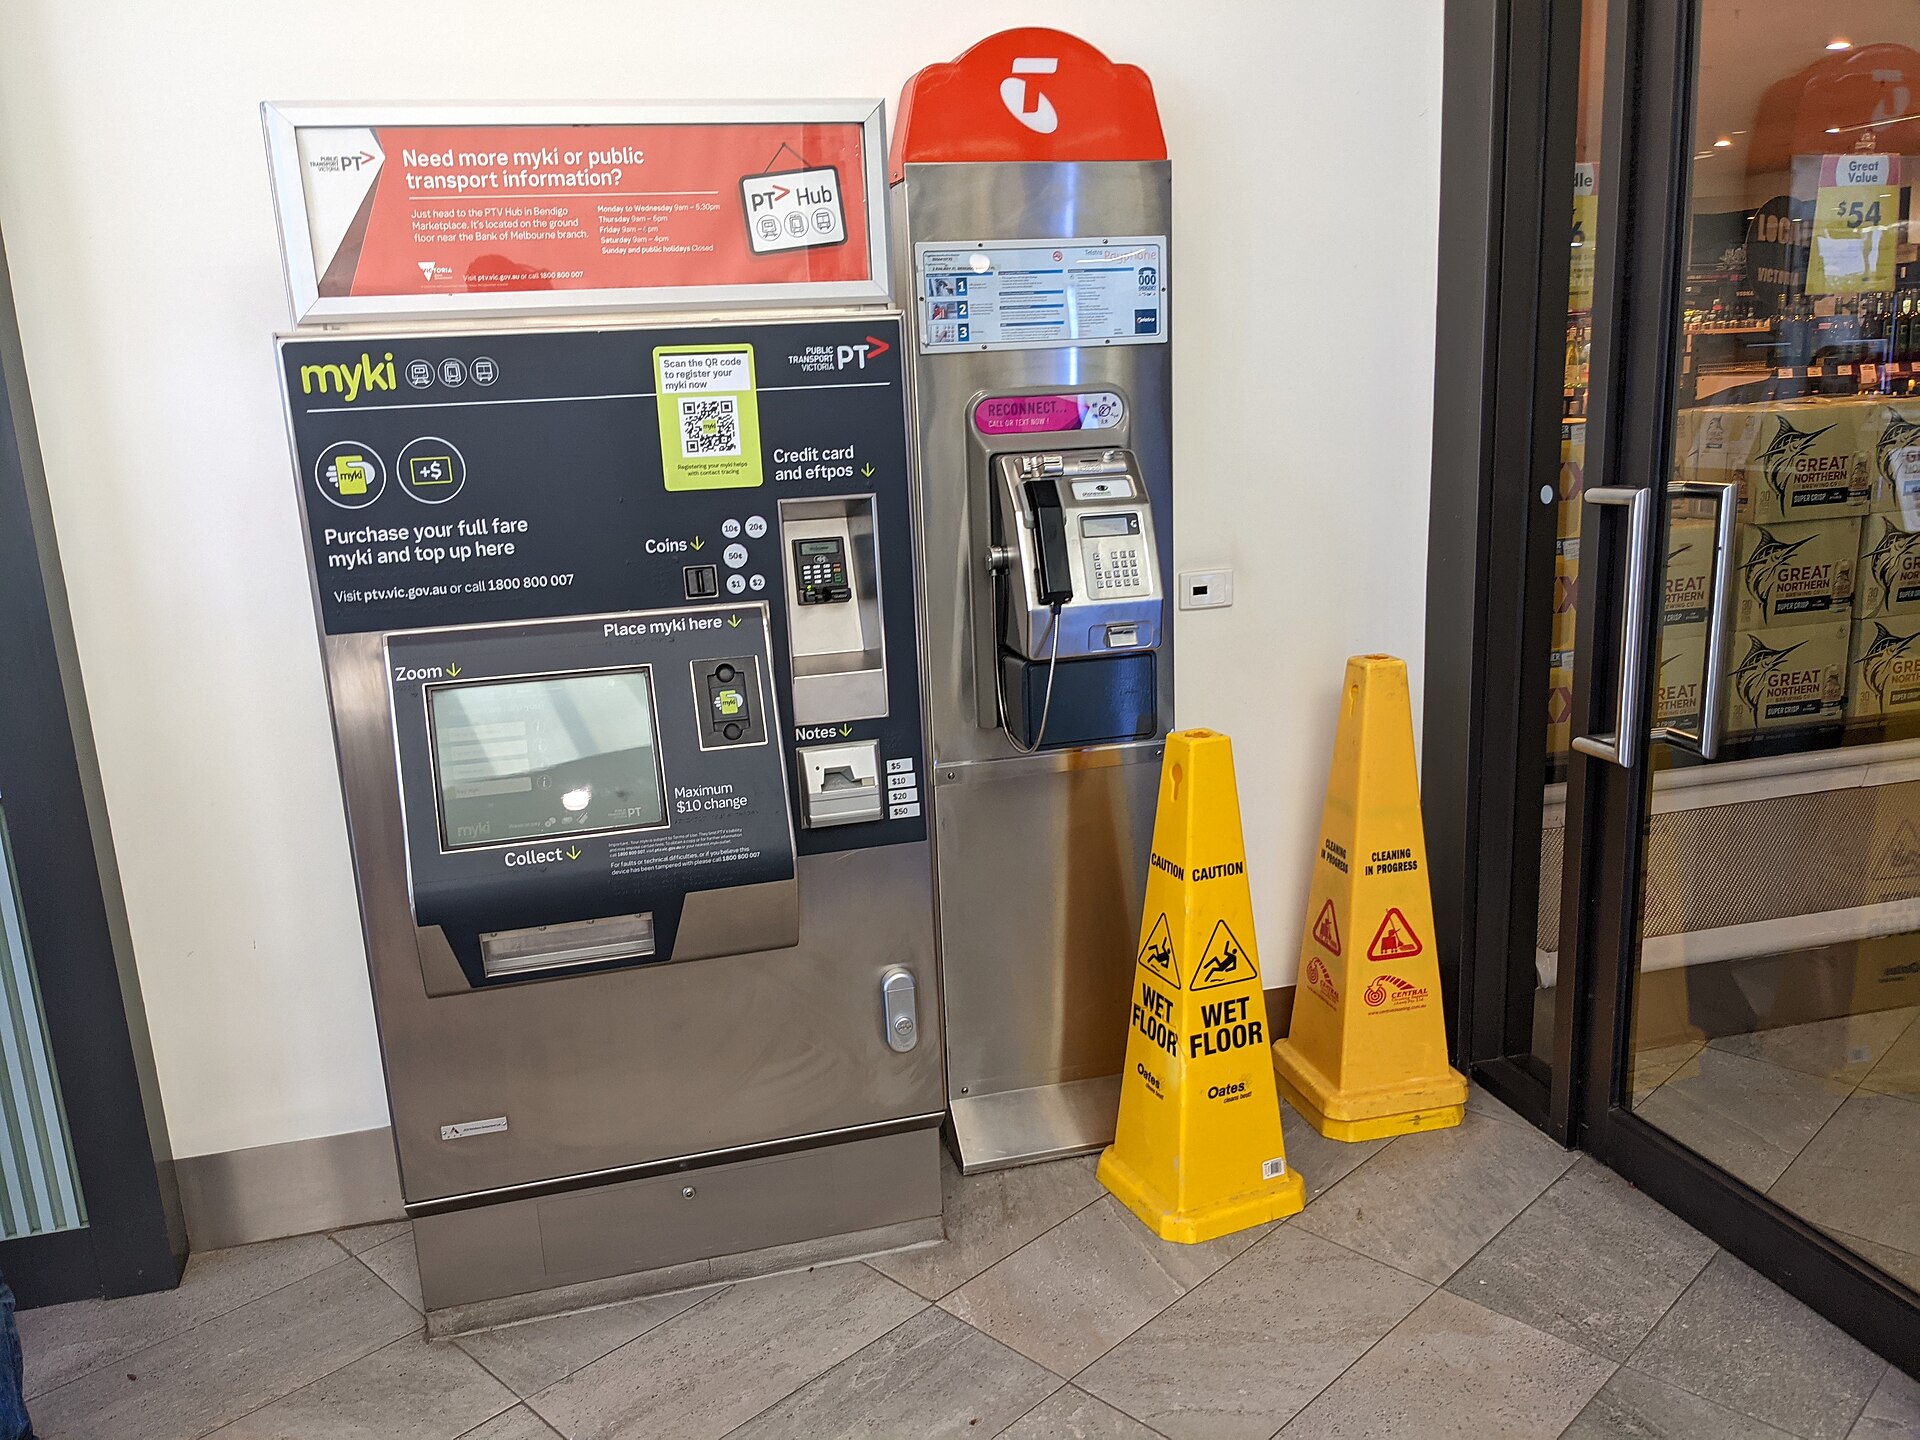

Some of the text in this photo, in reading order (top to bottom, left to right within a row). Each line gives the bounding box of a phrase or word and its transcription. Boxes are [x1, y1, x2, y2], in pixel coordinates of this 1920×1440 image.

[402, 147, 645, 170] Need more myki or public
[1848, 161, 1879, 171] Great
[405, 168, 623, 192] transport information?
[1848, 172, 1878, 183] Value
[796, 185, 832, 206] Hub
[411, 206, 569, 219] Just head to the PTV Hub in Bendigo
[597, 205, 624, 214] Monday
[634, 204, 673, 213] Wednesday
[1837, 200, 1882, 229] $54
[412, 218, 579, 232] Marketplace. It's located on the ground
[599, 215, 630, 224] Thursday
[414, 229, 589, 243] floor near the Bank of Melbourne branch.
[600, 236, 632, 244] Saturday
[601, 244, 714, 255] Sunday and public holidays Closed
[957, 280, 966, 292] 1
[1138, 274, 1157, 285] 000
[958, 303, 968, 316] 2
[959, 326, 968, 338] 3
[805, 346, 834, 355] PUBLIC
[663, 357, 741, 368] Scan the QR code
[788, 354, 834, 364] TRANSPORT
[664, 369, 732, 380] to register your
[801, 363, 835, 372] VICTORIA
[300, 352, 398, 402] myki
[665, 380, 707, 391] myki now
[773, 445, 855, 463] Credit card
[1795, 455, 1849, 472] GREAT
[340, 470, 363, 482] myki
[775, 464, 853, 482] and eftpos
[1793, 470, 1848, 484] NORTHERN
[1801, 481, 1829, 489] BREWING
[1793, 494, 1810, 503] SUPER
[1810, 492, 1827, 502] CRISP
[325, 517, 529, 546] Purchase your full fare
[645, 538, 688, 554] Coins
[328, 540, 515, 570] myki and top up here
[1777, 564, 1832, 582] GREAT
[333, 573, 575, 604] Visit ptv.vic.gov.au or call 1800 800 007
[731, 580, 741, 588] $1
[752, 578, 763, 586] $2
[1664, 576, 1706, 592] REAT
[1776, 579, 1830, 593] NORTHERN
[1776, 603, 1793, 612] SUPER
[1793, 600, 1809, 610] CRISP
[603, 616, 723, 638] Place myki here
[394, 664, 443, 682] Zoom
[1892, 659, 1920, 674] GRE
[1768, 669, 1821, 687] GREAT
[1657, 684, 1697, 700] REAT
[1766, 684, 1820, 698] NORTHERN
[722, 698, 736, 708] myki
[1767, 707, 1784, 716] SUPER
[1784, 705, 1800, 714] CRISP
[795, 726, 837, 742] Notes
[891, 762, 902, 770] $5
[892, 777, 906, 785] $10
[674, 783, 733, 799] Maximum
[892, 792, 908, 801] $20
[677, 794, 748, 814] $10 change
[893, 807, 909, 816] $50
[457, 820, 491, 839] myki
[1325, 838, 1347, 860] CLEANING
[1371, 848, 1411, 862] CLEANING
[505, 849, 564, 867] Collect
[611, 851, 761, 876] device has been tampered with please call 1800 800 007
[1321, 848, 1348, 874] IN PROGRESS
[1151, 852, 1185, 881] CAUTION
[1192, 861, 1244, 882] CAUTION
[1365, 860, 1418, 876] IN PROGRESS
[1391, 987, 1429, 999] CENTRAL
[1142, 982, 1174, 1024] WET
[1201, 996, 1250, 1029] WET
[1132, 1002, 1178, 1058] FLOOR
[1189, 1021, 1263, 1059] FLOOR
[1137, 1062, 1160, 1089] Oates
[1207, 1081, 1246, 1099] Oates
